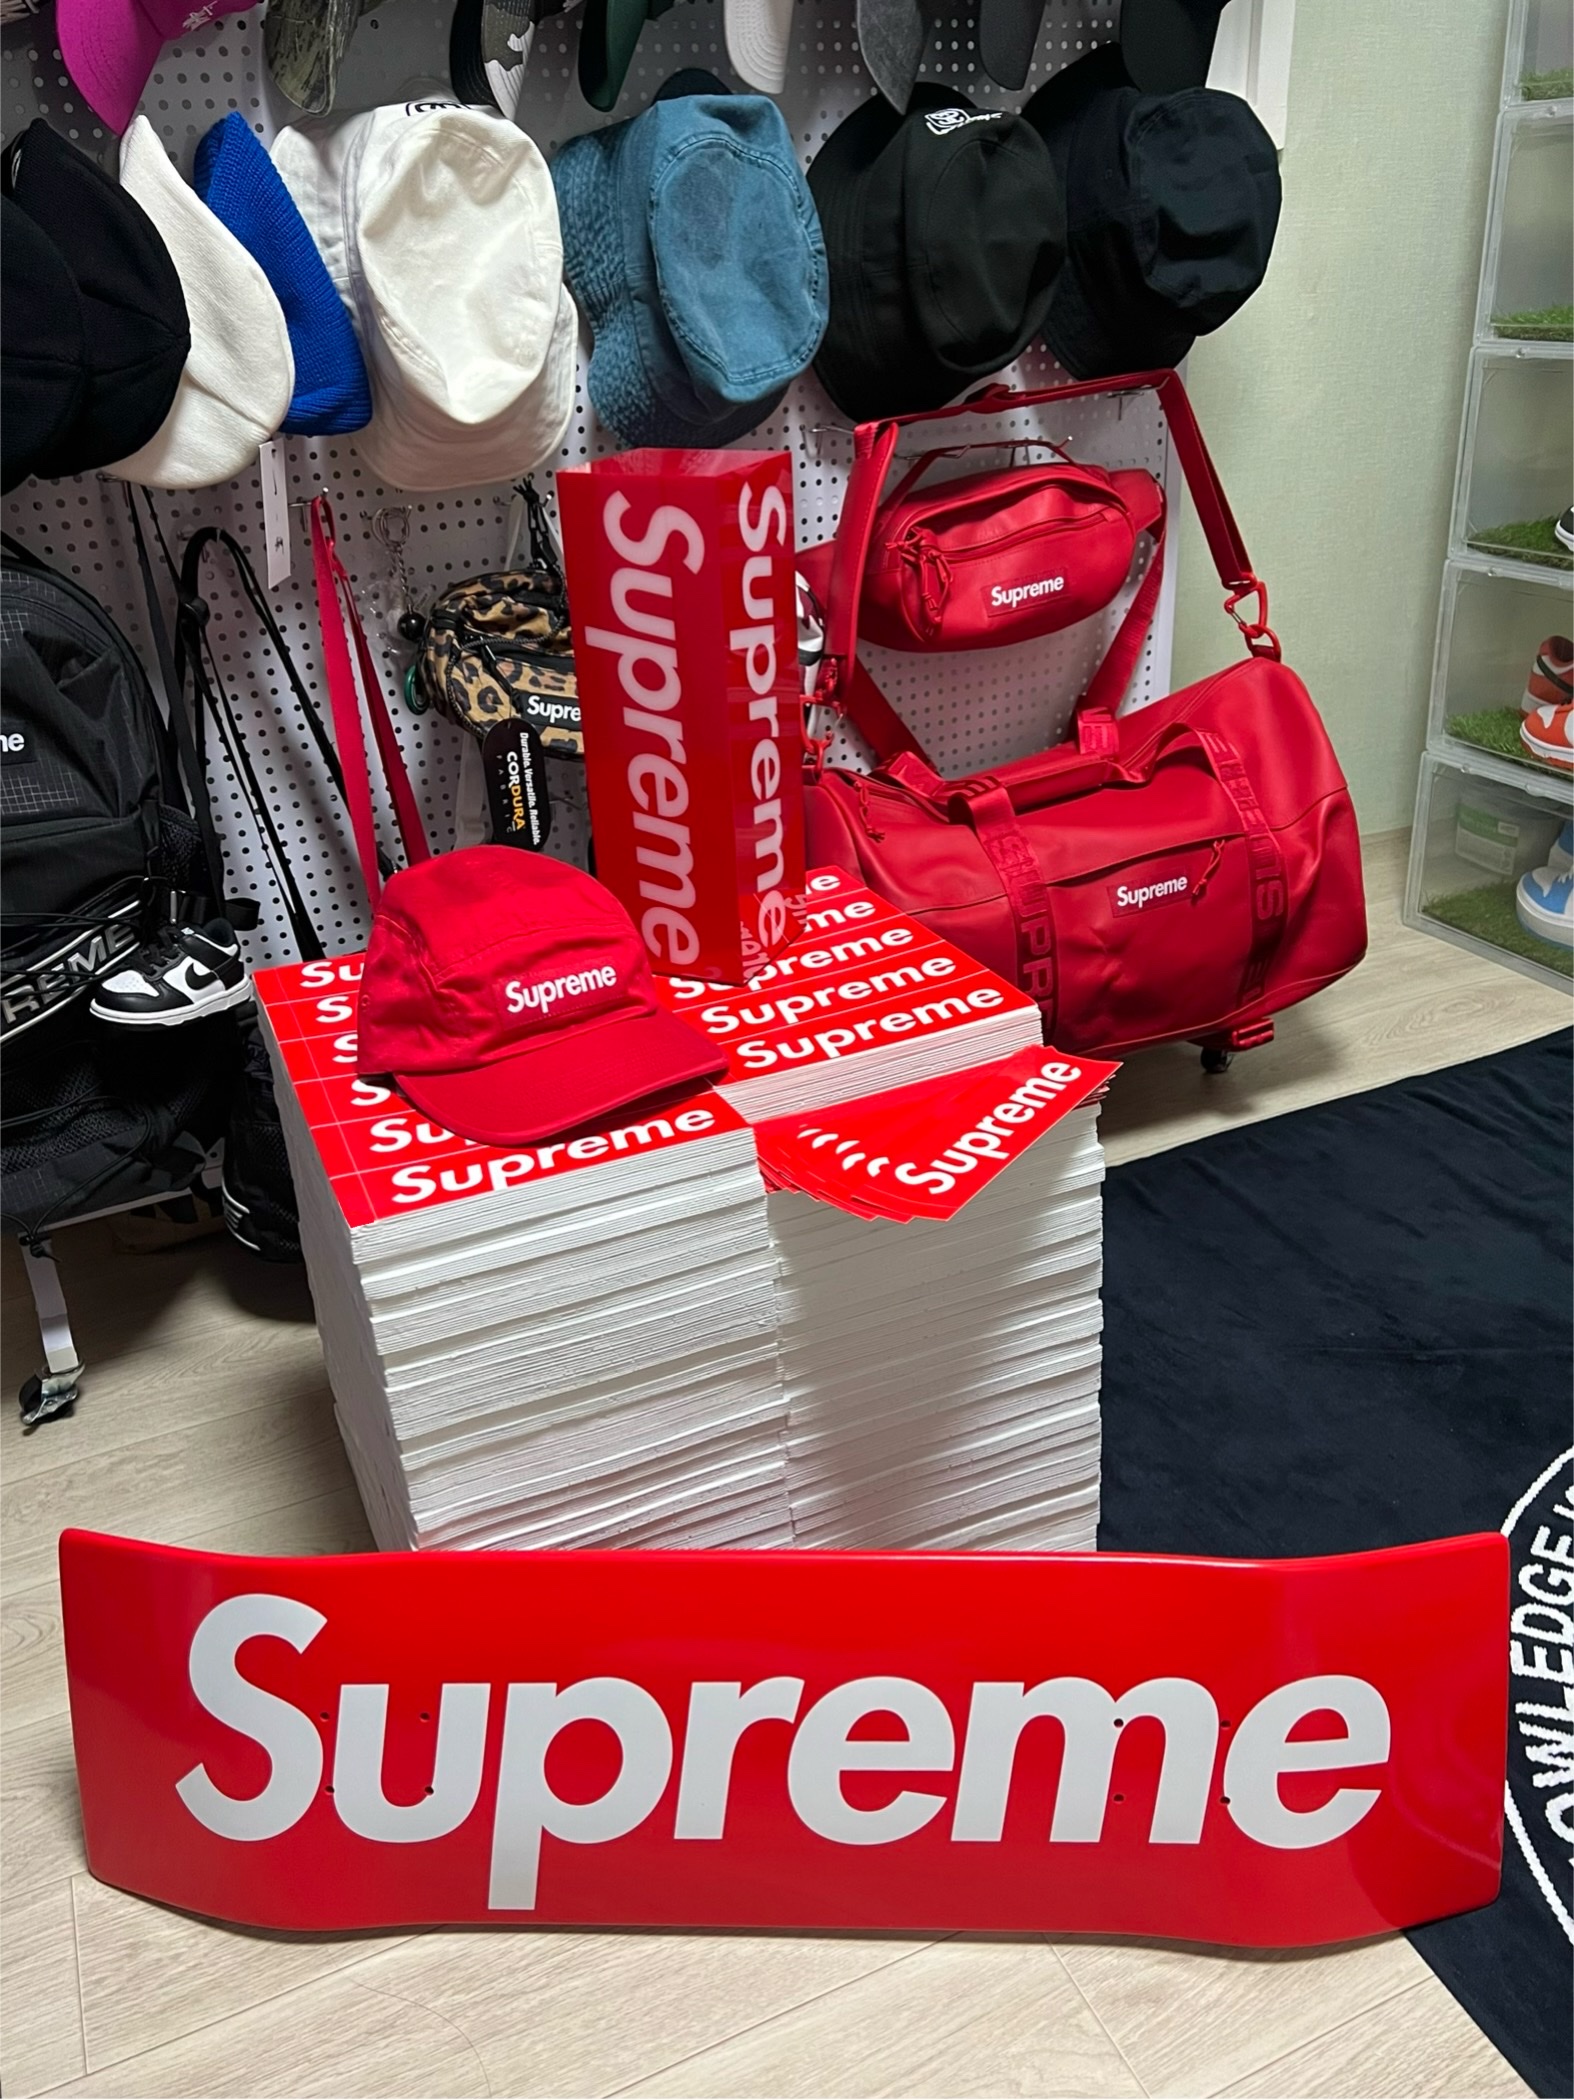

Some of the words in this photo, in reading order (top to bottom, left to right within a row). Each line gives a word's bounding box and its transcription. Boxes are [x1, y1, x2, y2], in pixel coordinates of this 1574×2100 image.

[990, 575, 1065, 607] Supreme
[527, 695, 582, 723] Supre
[585, 491, 705, 966] Supreme
[730, 481, 786, 947] Supreme
[506, 751, 526, 830] CORDURA
[1116, 874, 1189, 910] Supreme
[2, 925, 136, 1024] REME
[505, 966, 617, 1014] Supreme
[668, 928, 914, 999] Spreme
[701, 957, 957, 1034] Supreme
[736, 988, 1005, 1069] Supreme
[391, 1109, 716, 1203] Supreme
[894, 1061, 1082, 1195] Supreme
[174, 1592, 1391, 1911] Supreme
